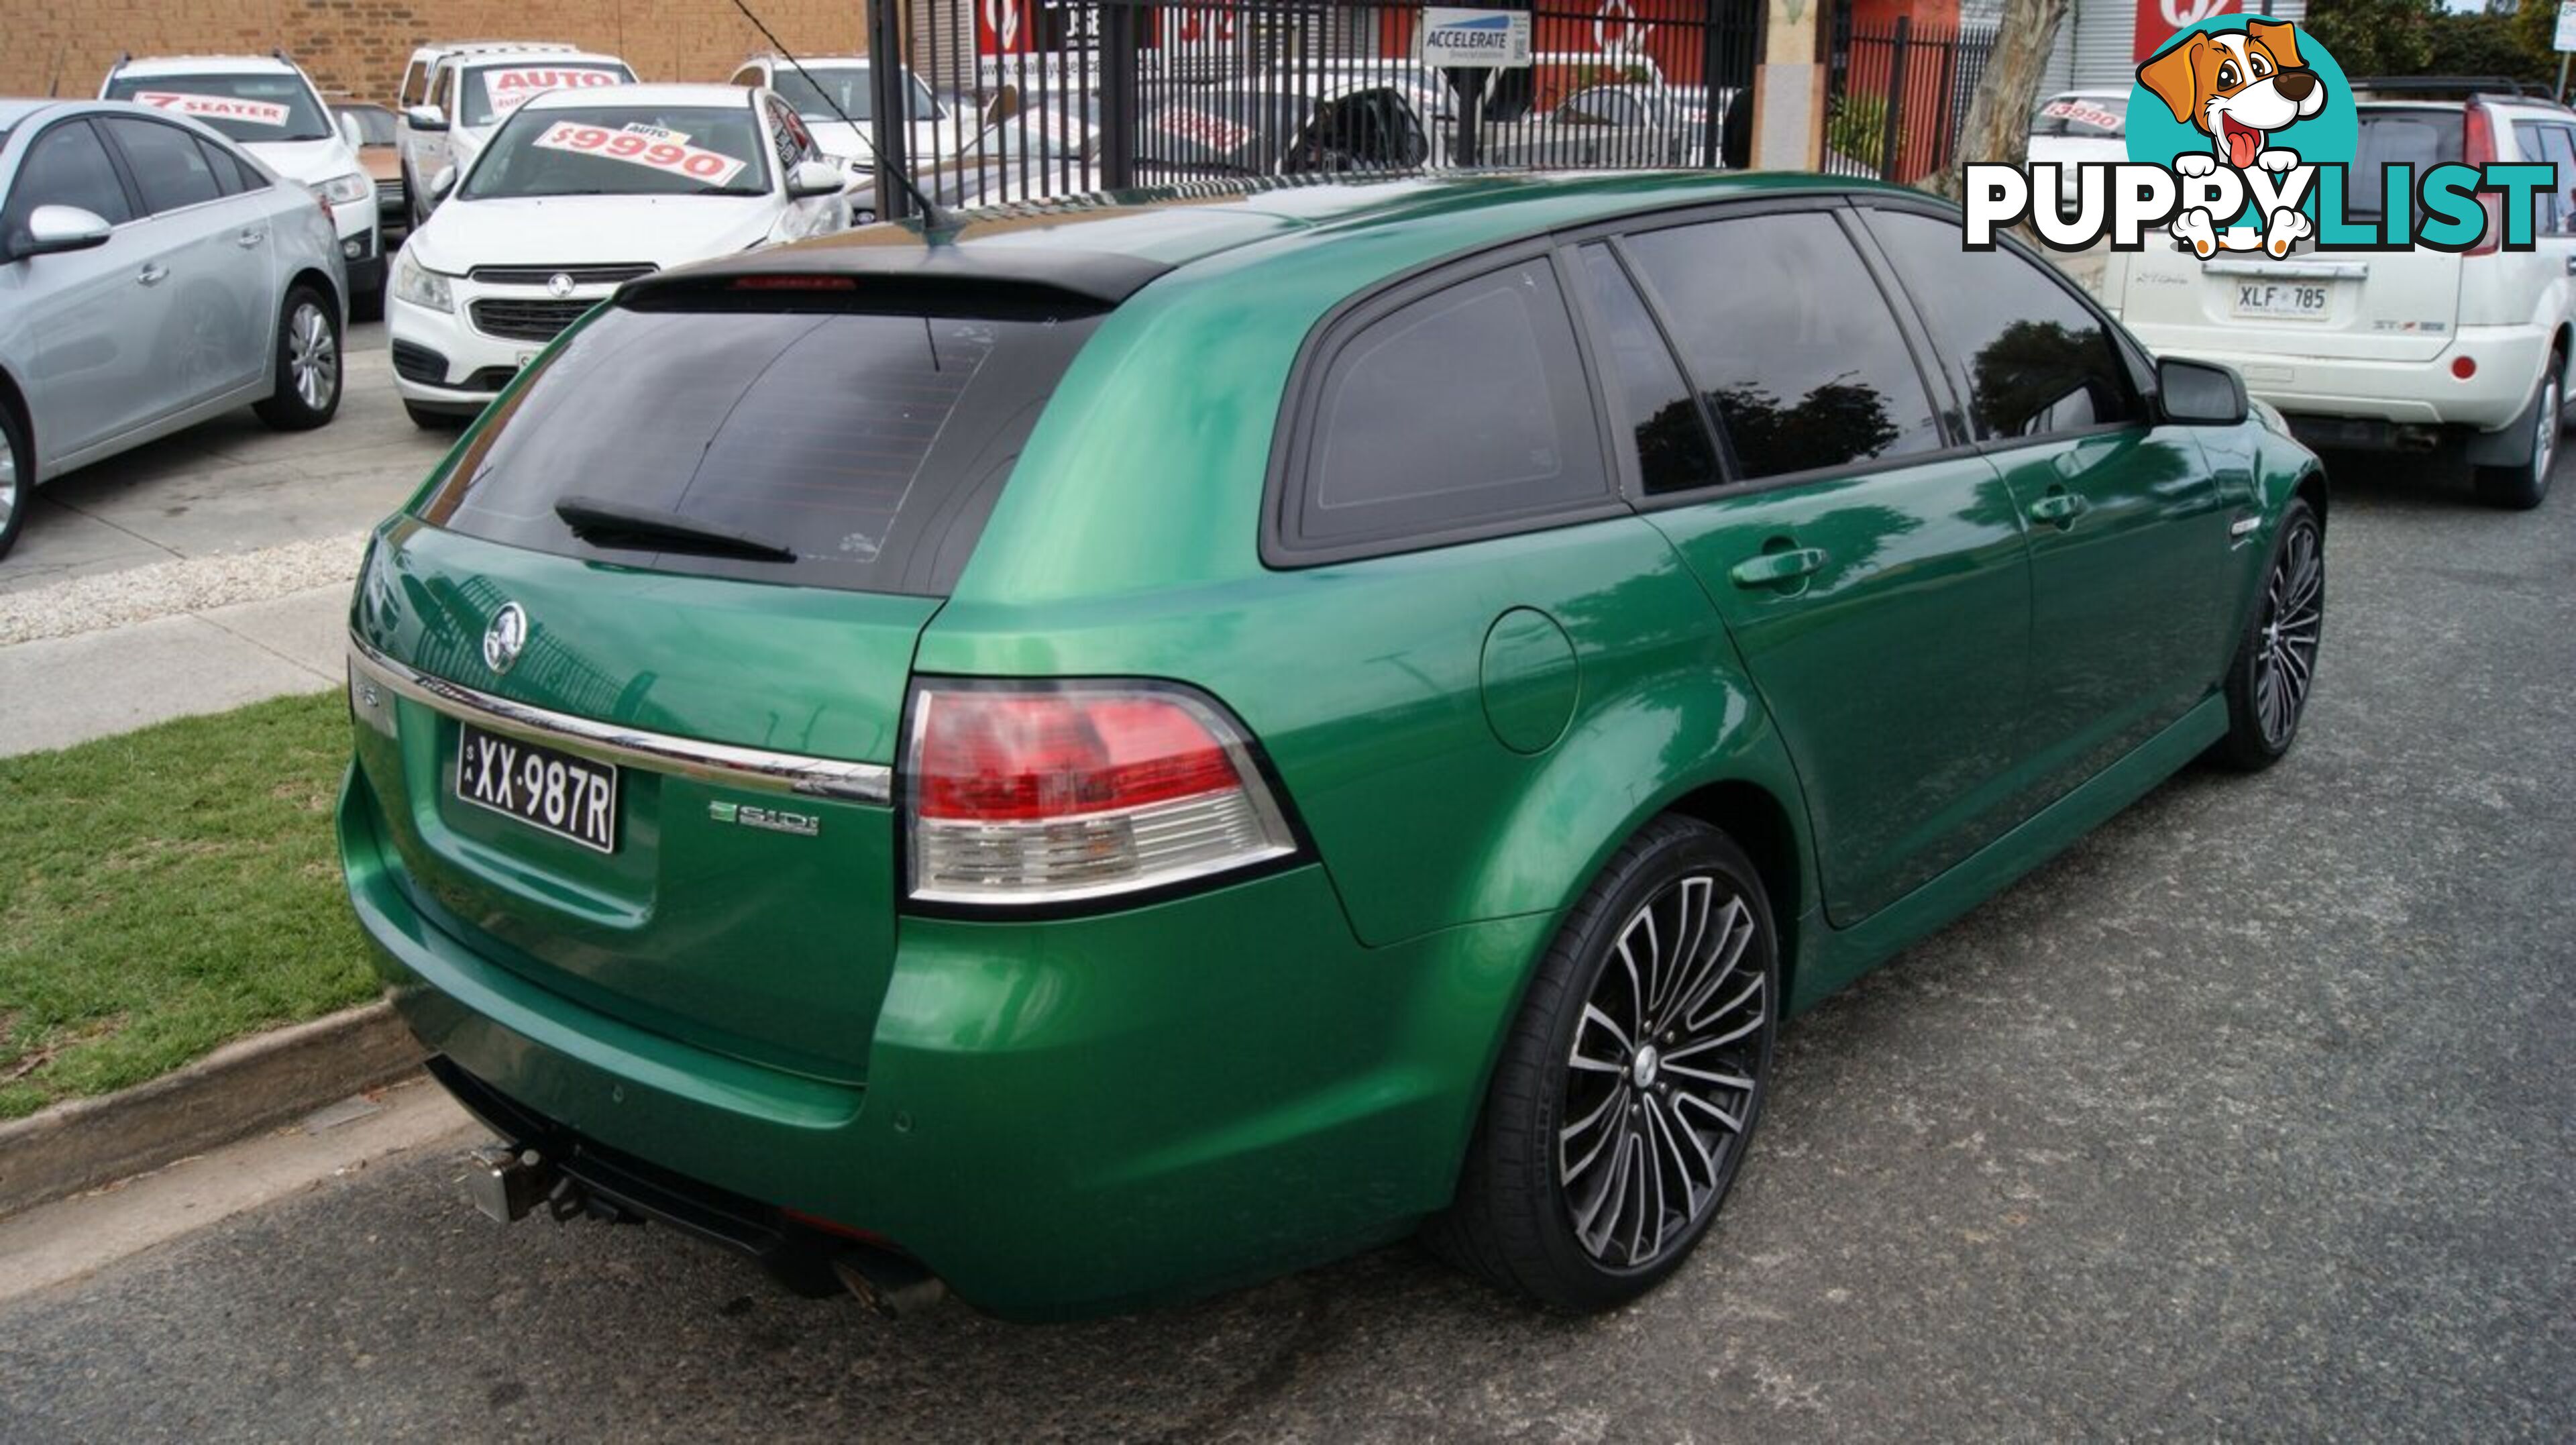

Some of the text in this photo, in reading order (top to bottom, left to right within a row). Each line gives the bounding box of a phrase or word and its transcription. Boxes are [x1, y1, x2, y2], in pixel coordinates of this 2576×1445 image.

[1426, 30, 1507, 49] ACCELERATE
[497, 71, 614, 89] AUTO
[184, 101, 280, 119] SEATER
[627, 125, 670, 138] AUTO
[551, 127, 726, 176] $9990
[2239, 286, 2326, 309] XLF 785
[739, 806, 820, 836] SIDI
